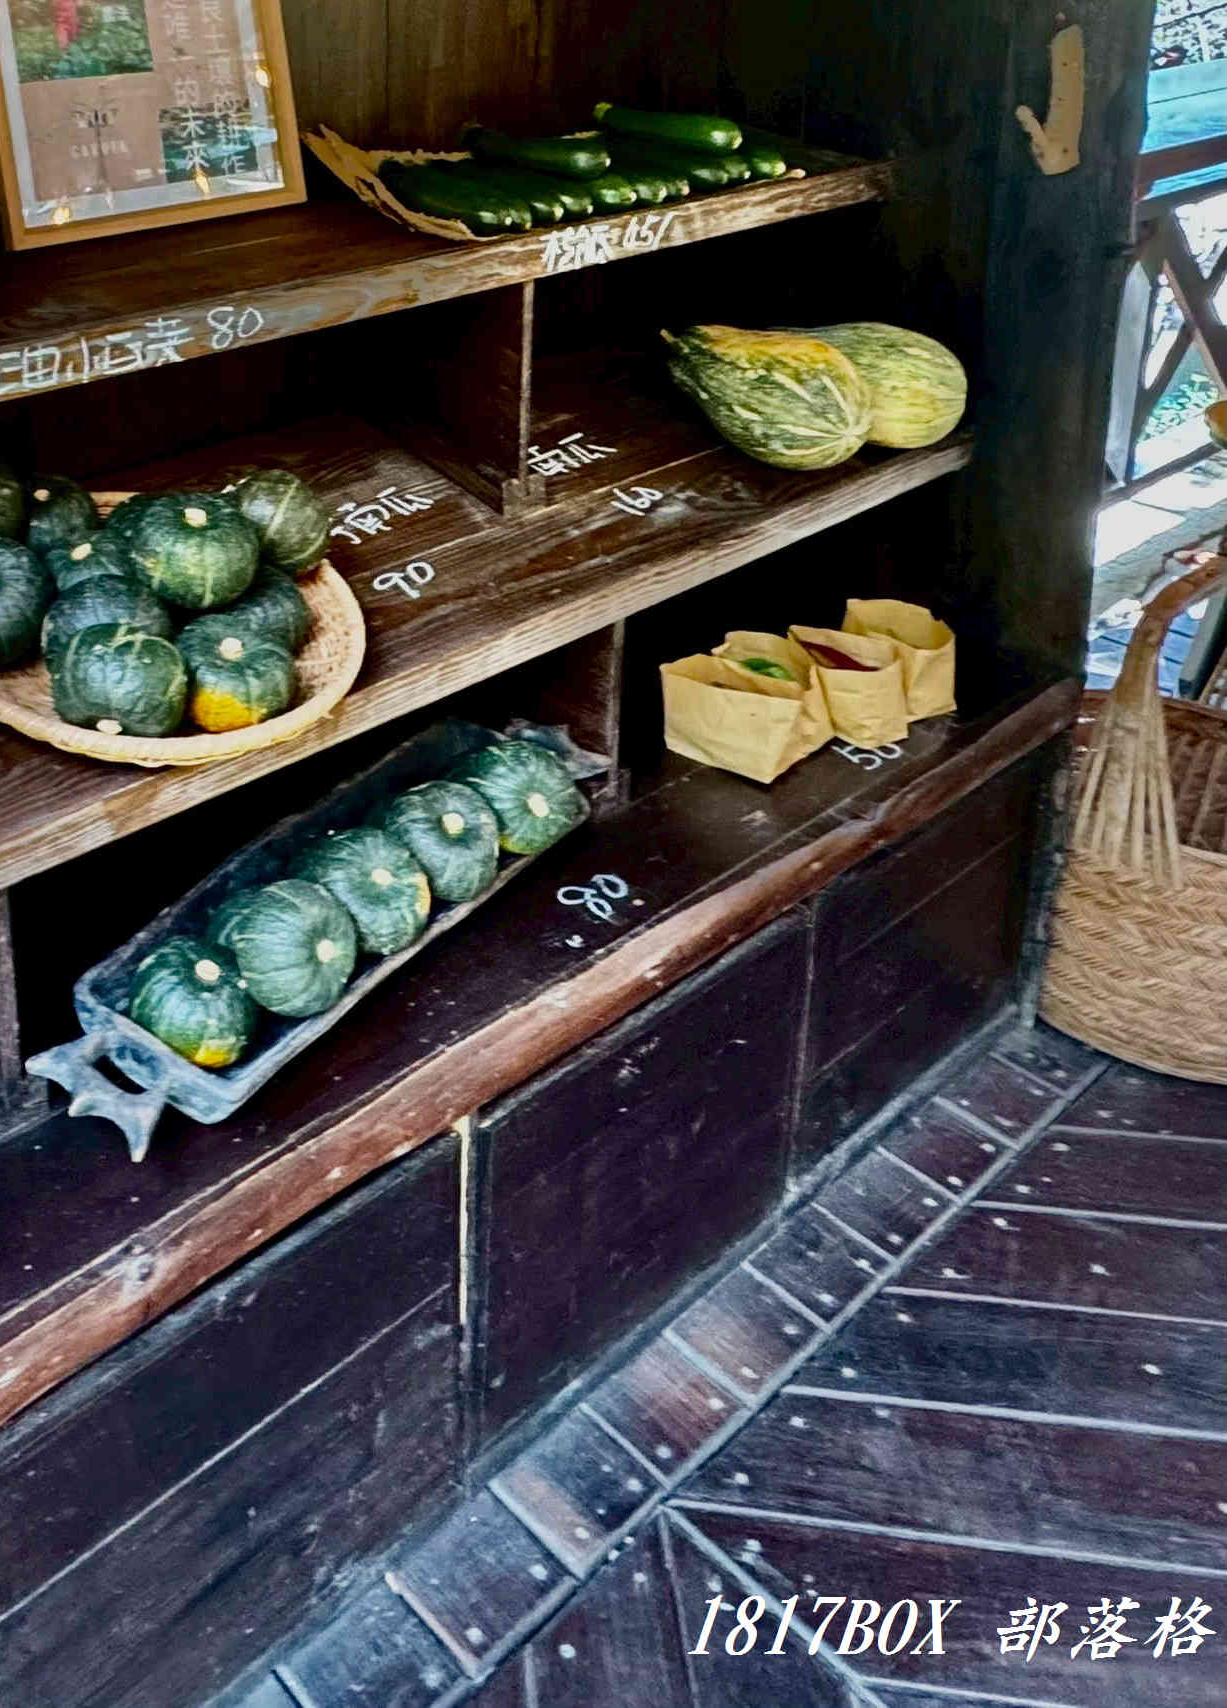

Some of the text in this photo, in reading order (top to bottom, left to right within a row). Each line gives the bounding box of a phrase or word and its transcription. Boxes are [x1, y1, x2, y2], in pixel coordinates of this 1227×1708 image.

[207, 305, 265, 350] 80
[611, 486, 664, 517] 160
[373, 561, 436, 600] 90
